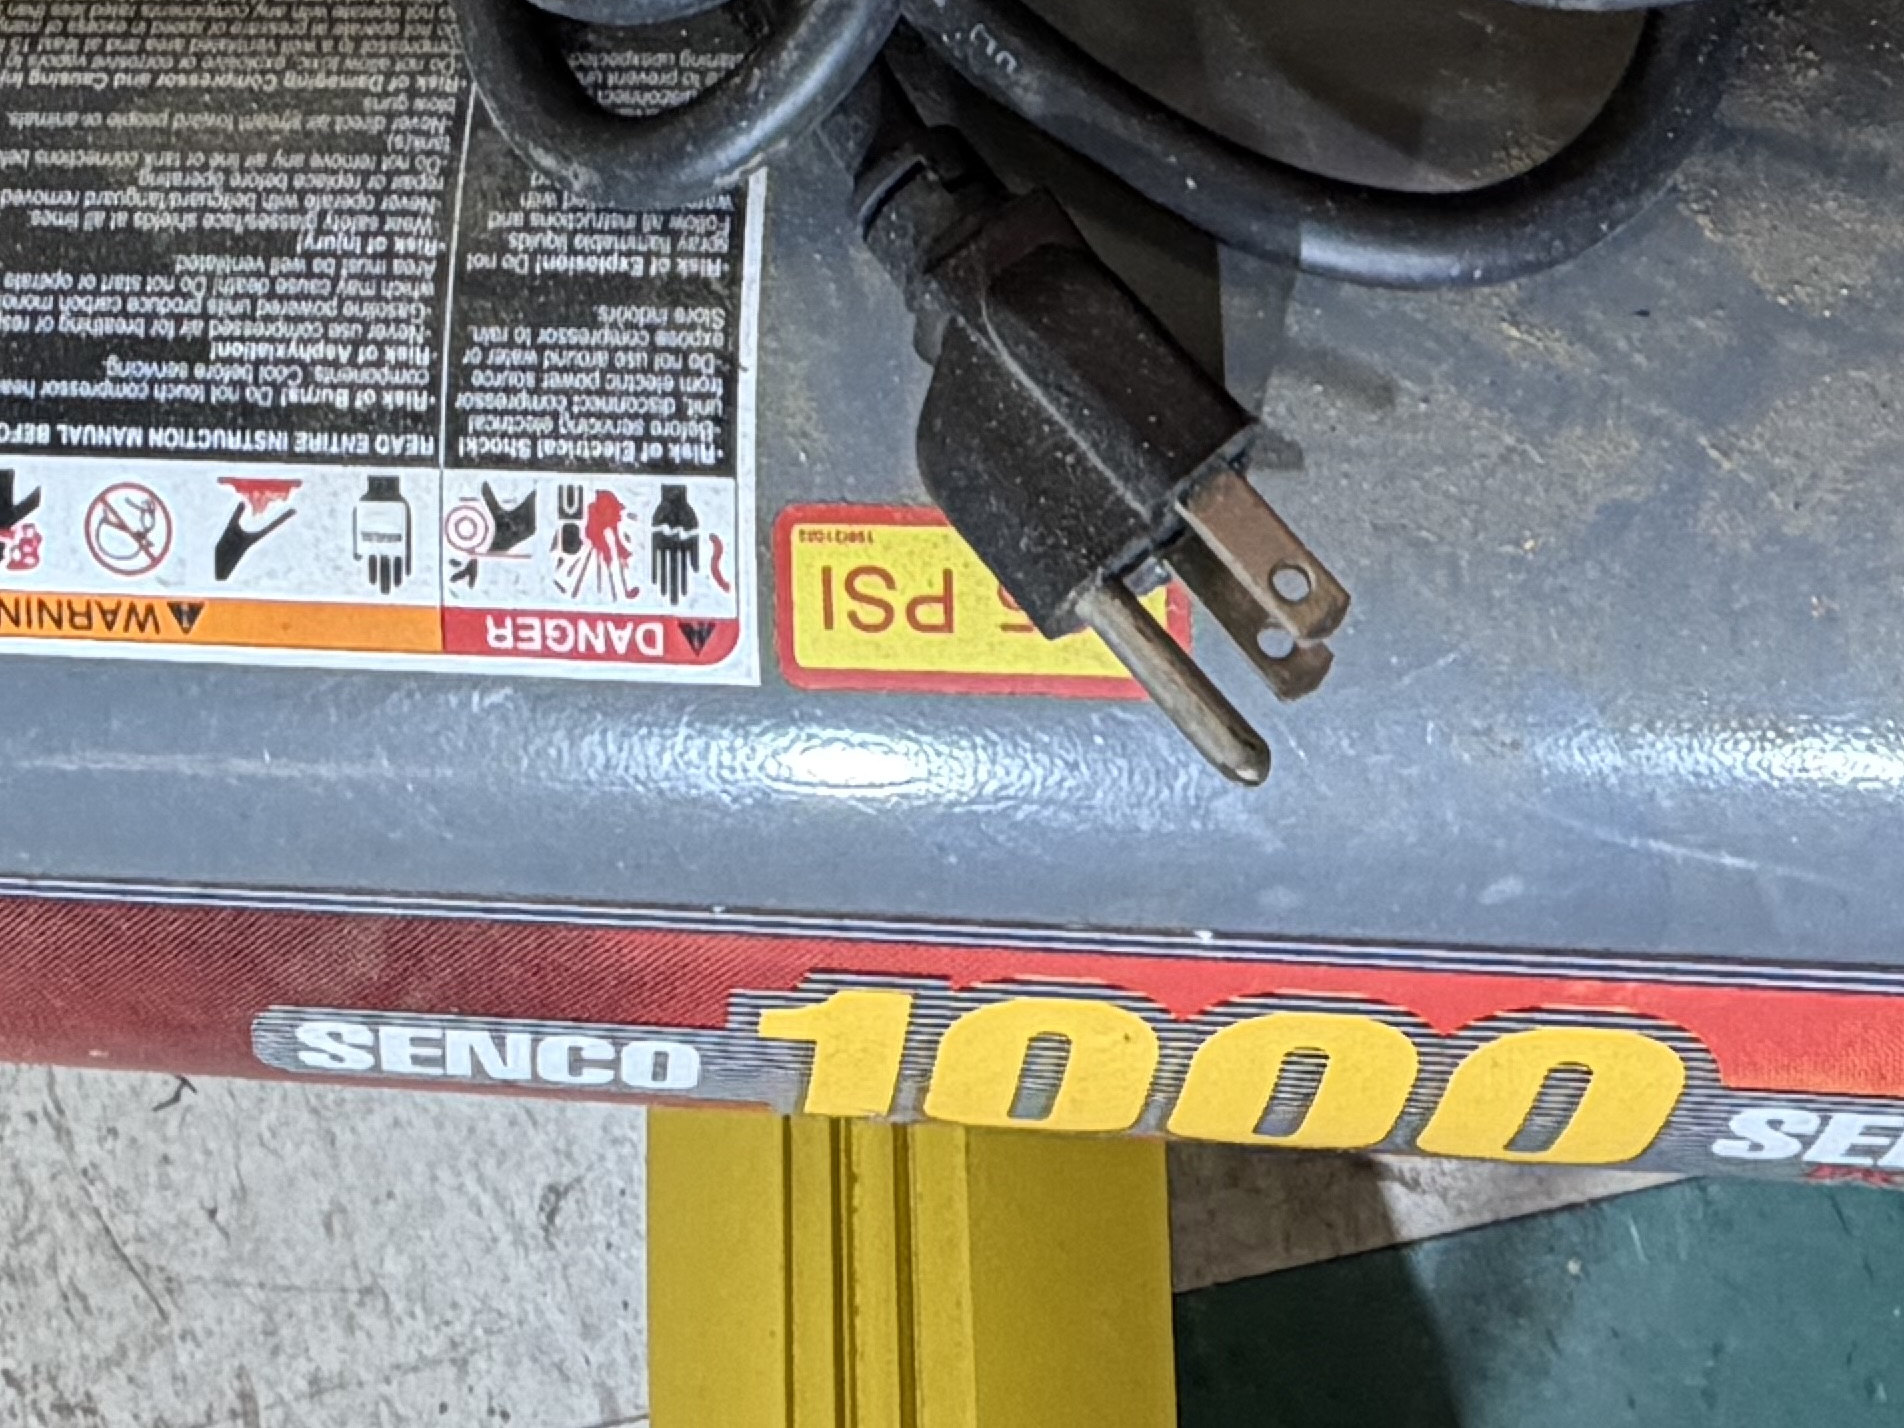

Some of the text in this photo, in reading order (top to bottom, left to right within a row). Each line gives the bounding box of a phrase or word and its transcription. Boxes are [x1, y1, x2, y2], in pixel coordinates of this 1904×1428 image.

[467, 253, 496, 272] not
[502, 254, 529, 274] Do
[650, 257, 670, 277] of
[677, 258, 721, 278] Risk
[462, 347, 482, 363] or
[488, 348, 537, 364] water
[545, 350, 608, 368] around
[616, 351, 647, 368] use
[655, 353, 683, 371] not
[472, 368, 723, 394] from electric power source
[456, 389, 567, 410] compressor
[574, 395, 675, 415] disconnect
[469, 415, 553, 434] electrical
[559, 413, 644, 437] servicing
[57, 424, 143, 447] MANUAL
[149, 427, 288, 453] INSTRUCTION
[294, 431, 369, 455] ENTIRE
[376, 432, 435, 455] READ
[537, 439, 636, 460] Electrical
[641, 442, 662, 461] of
[669, 442, 715, 464] Risk
[821, 565, 954, 634] PSI
[485, 614, 665, 657] DANGER
[294, 1021, 698, 1092] SENCO
[755, 994, 1687, 1165] 1000
